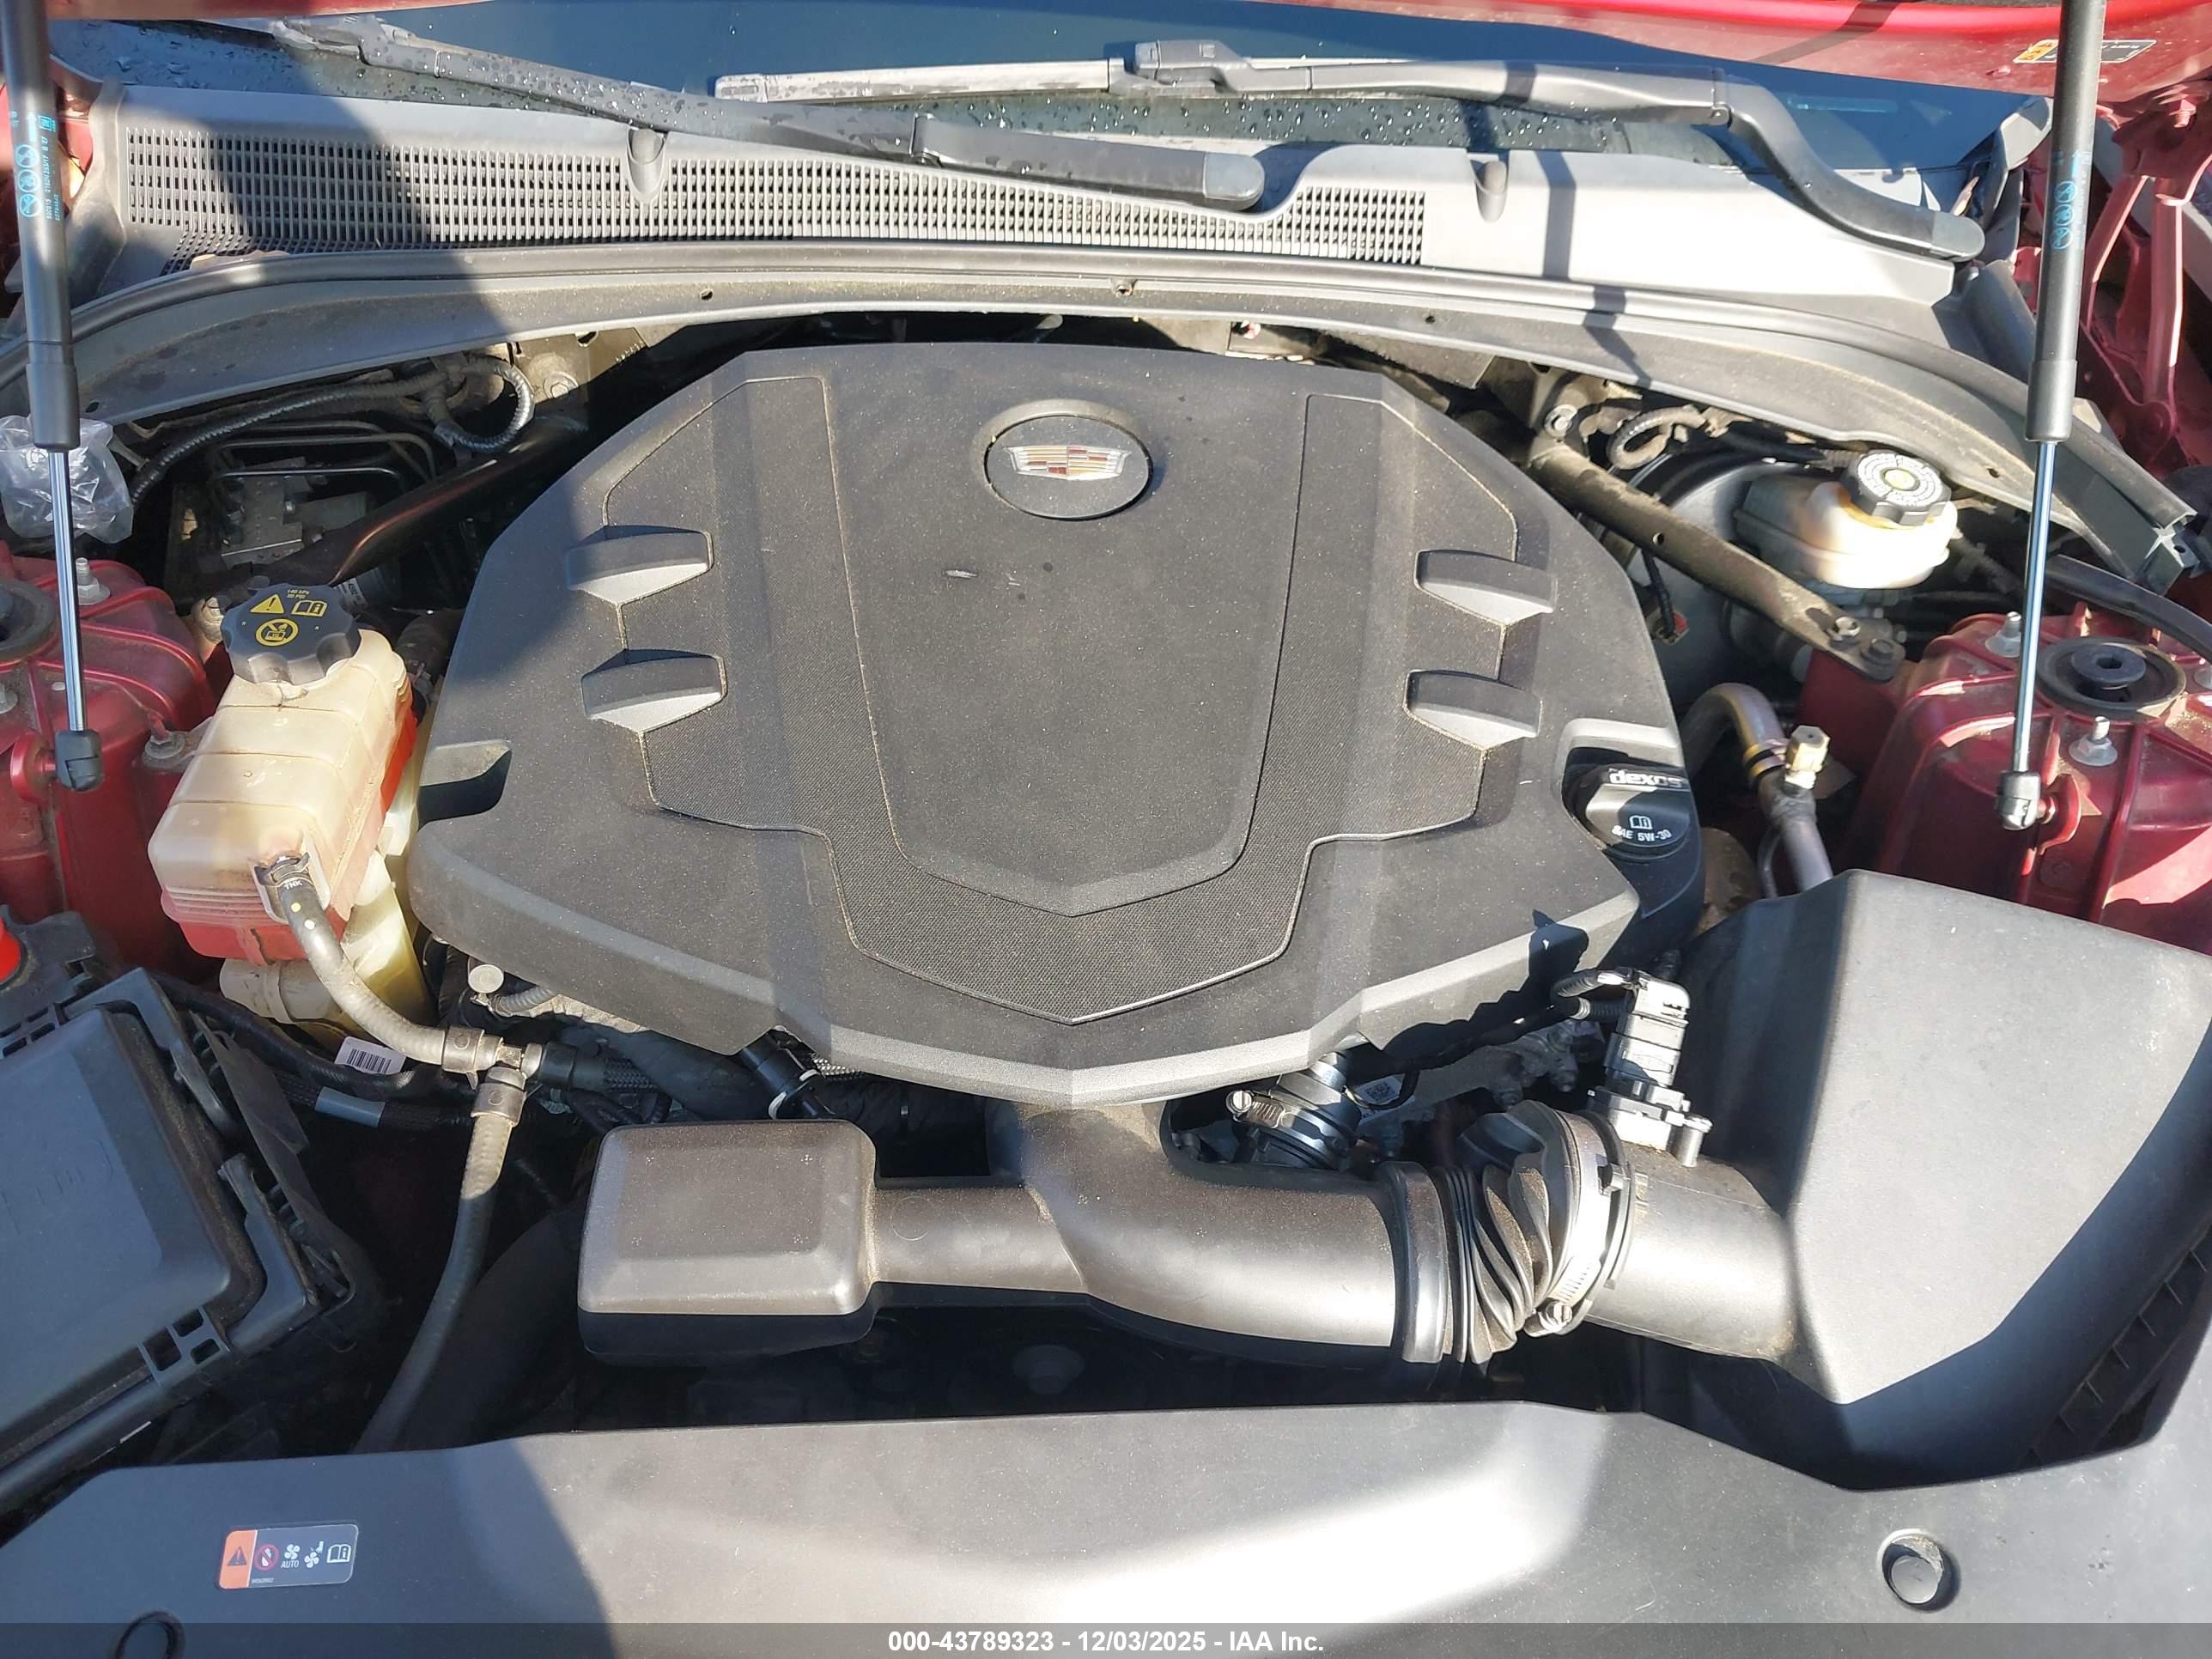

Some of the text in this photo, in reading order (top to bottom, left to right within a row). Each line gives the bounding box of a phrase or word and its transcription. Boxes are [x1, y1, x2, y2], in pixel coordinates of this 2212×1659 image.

[1609, 769, 1683, 787] dexos
[1612, 825, 1672, 842] SAE 5W-30
[281, 1560, 299, 1569] AUTO
